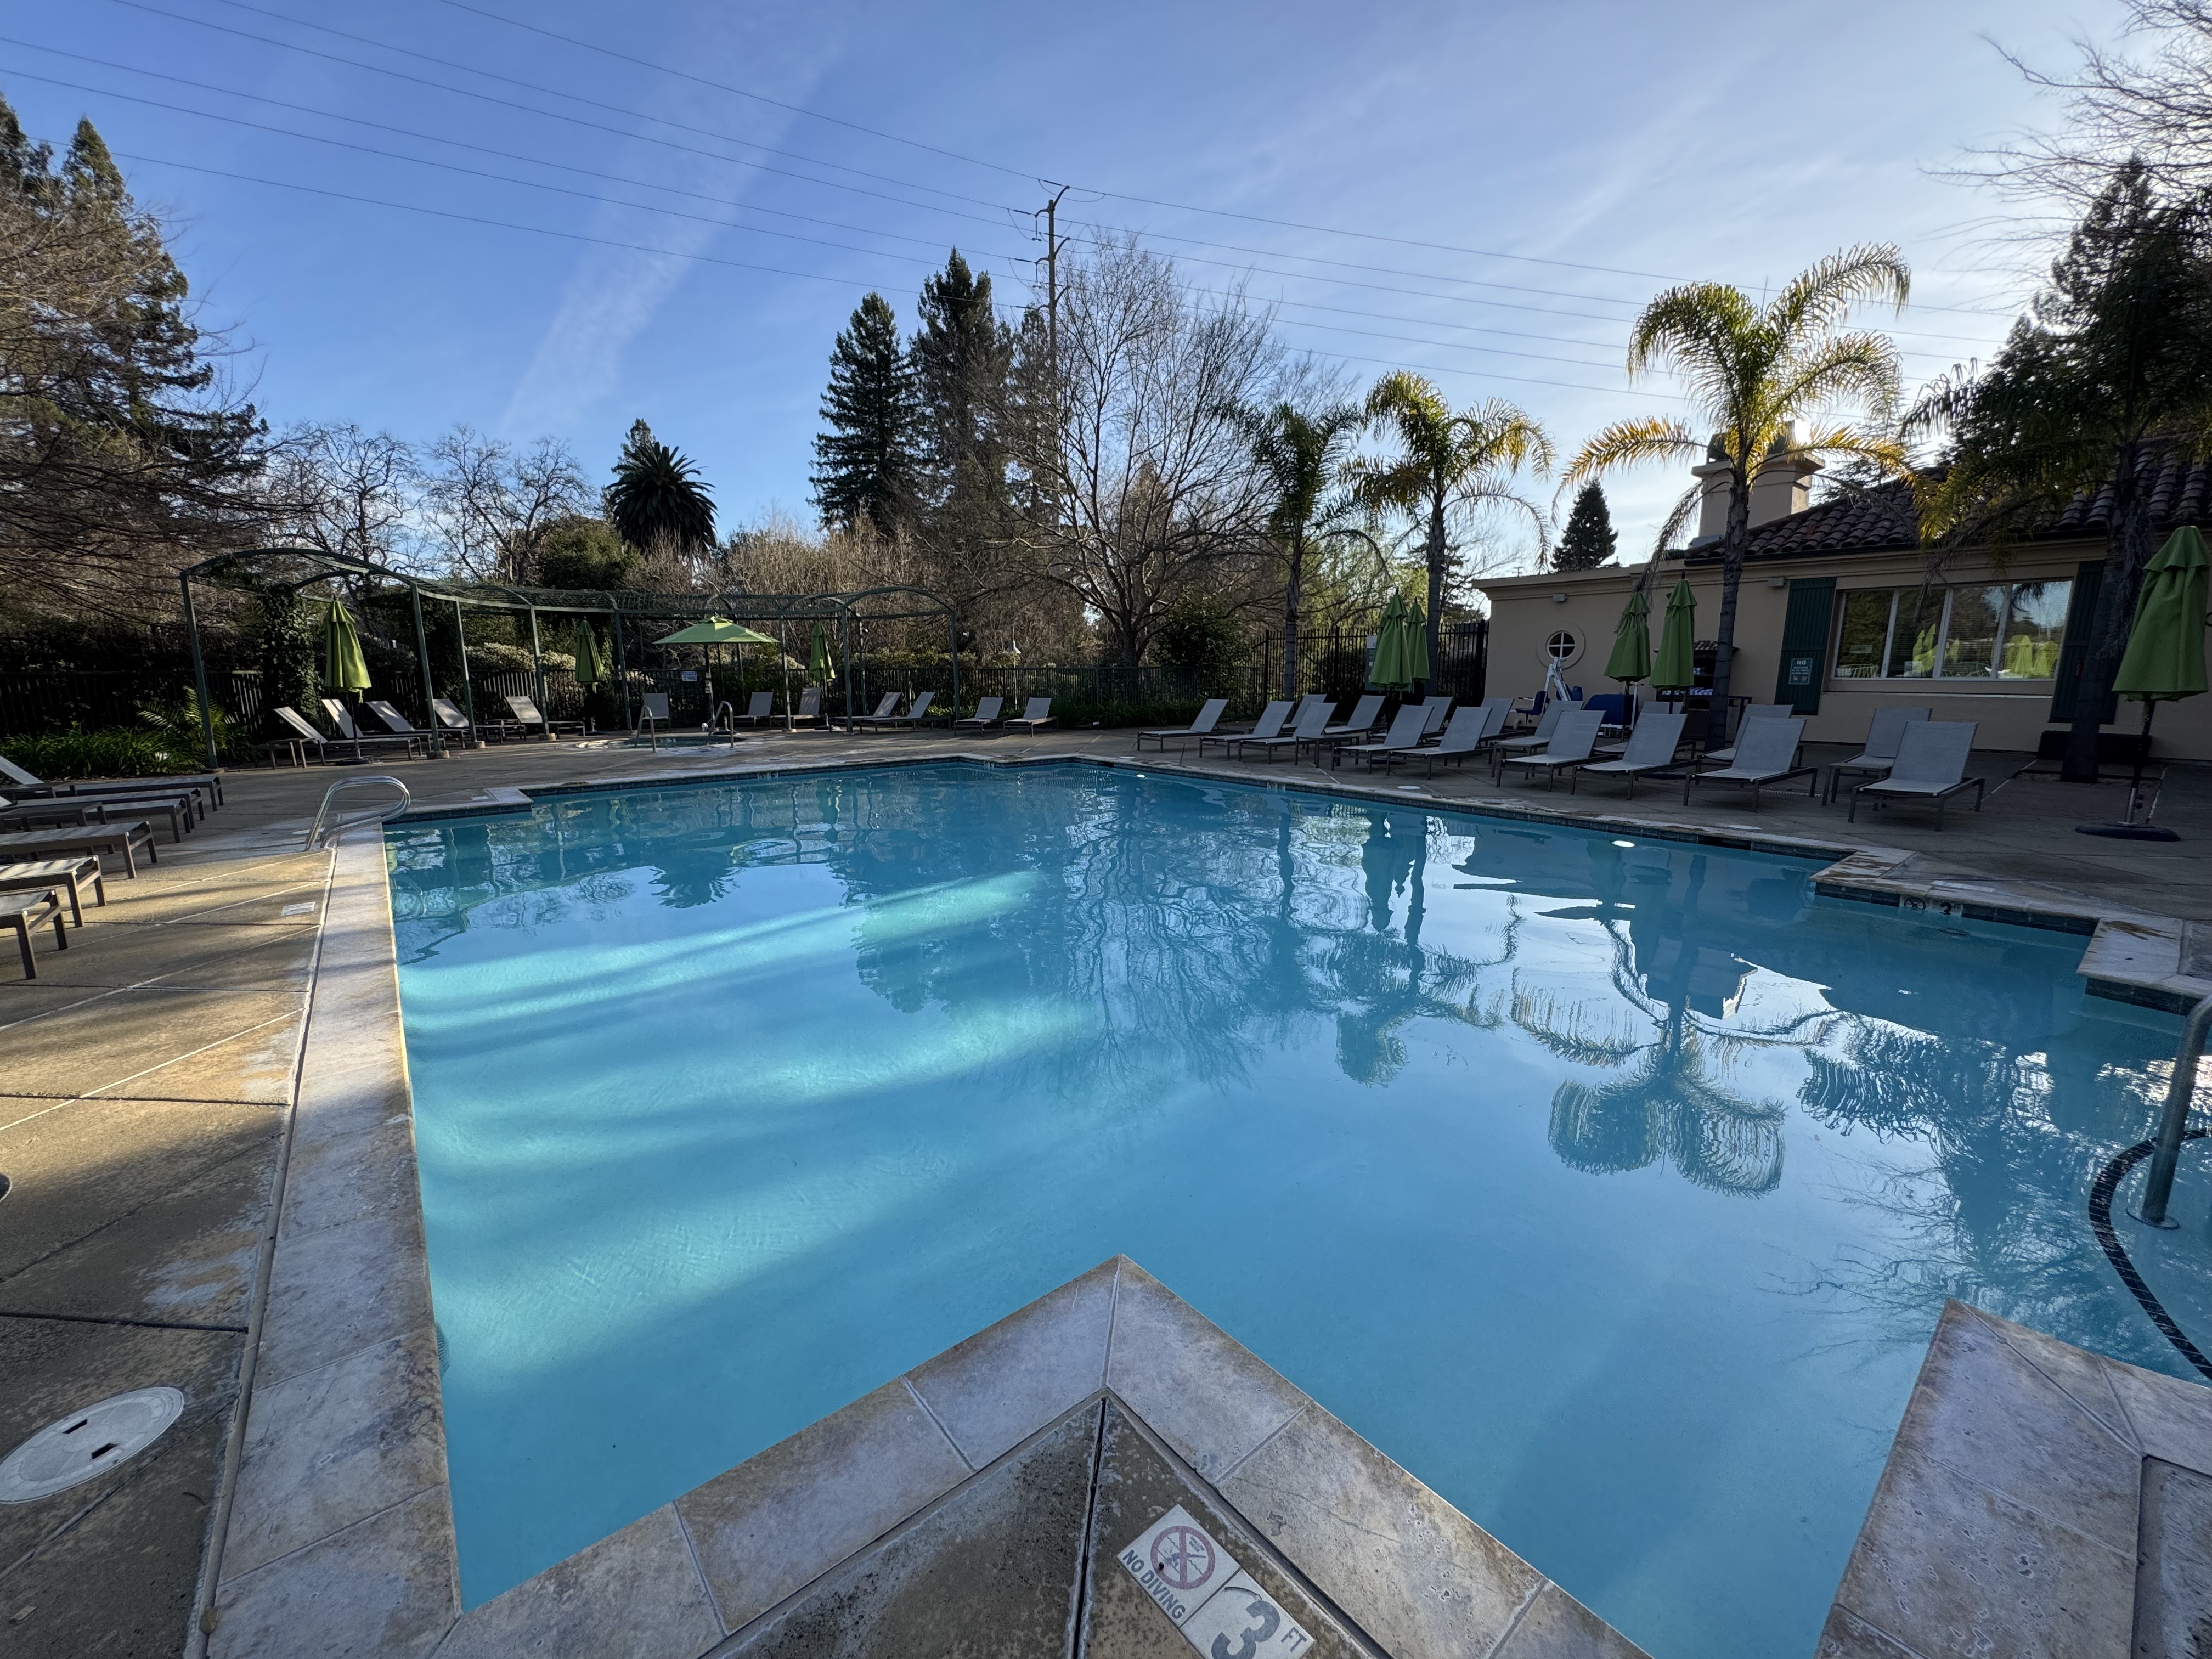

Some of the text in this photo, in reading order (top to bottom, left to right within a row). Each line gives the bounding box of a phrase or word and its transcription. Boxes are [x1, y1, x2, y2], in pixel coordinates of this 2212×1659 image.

[1123, 1549, 1186, 1620] NO DIVING
[1211, 1601, 1307, 1659] 3 FT
